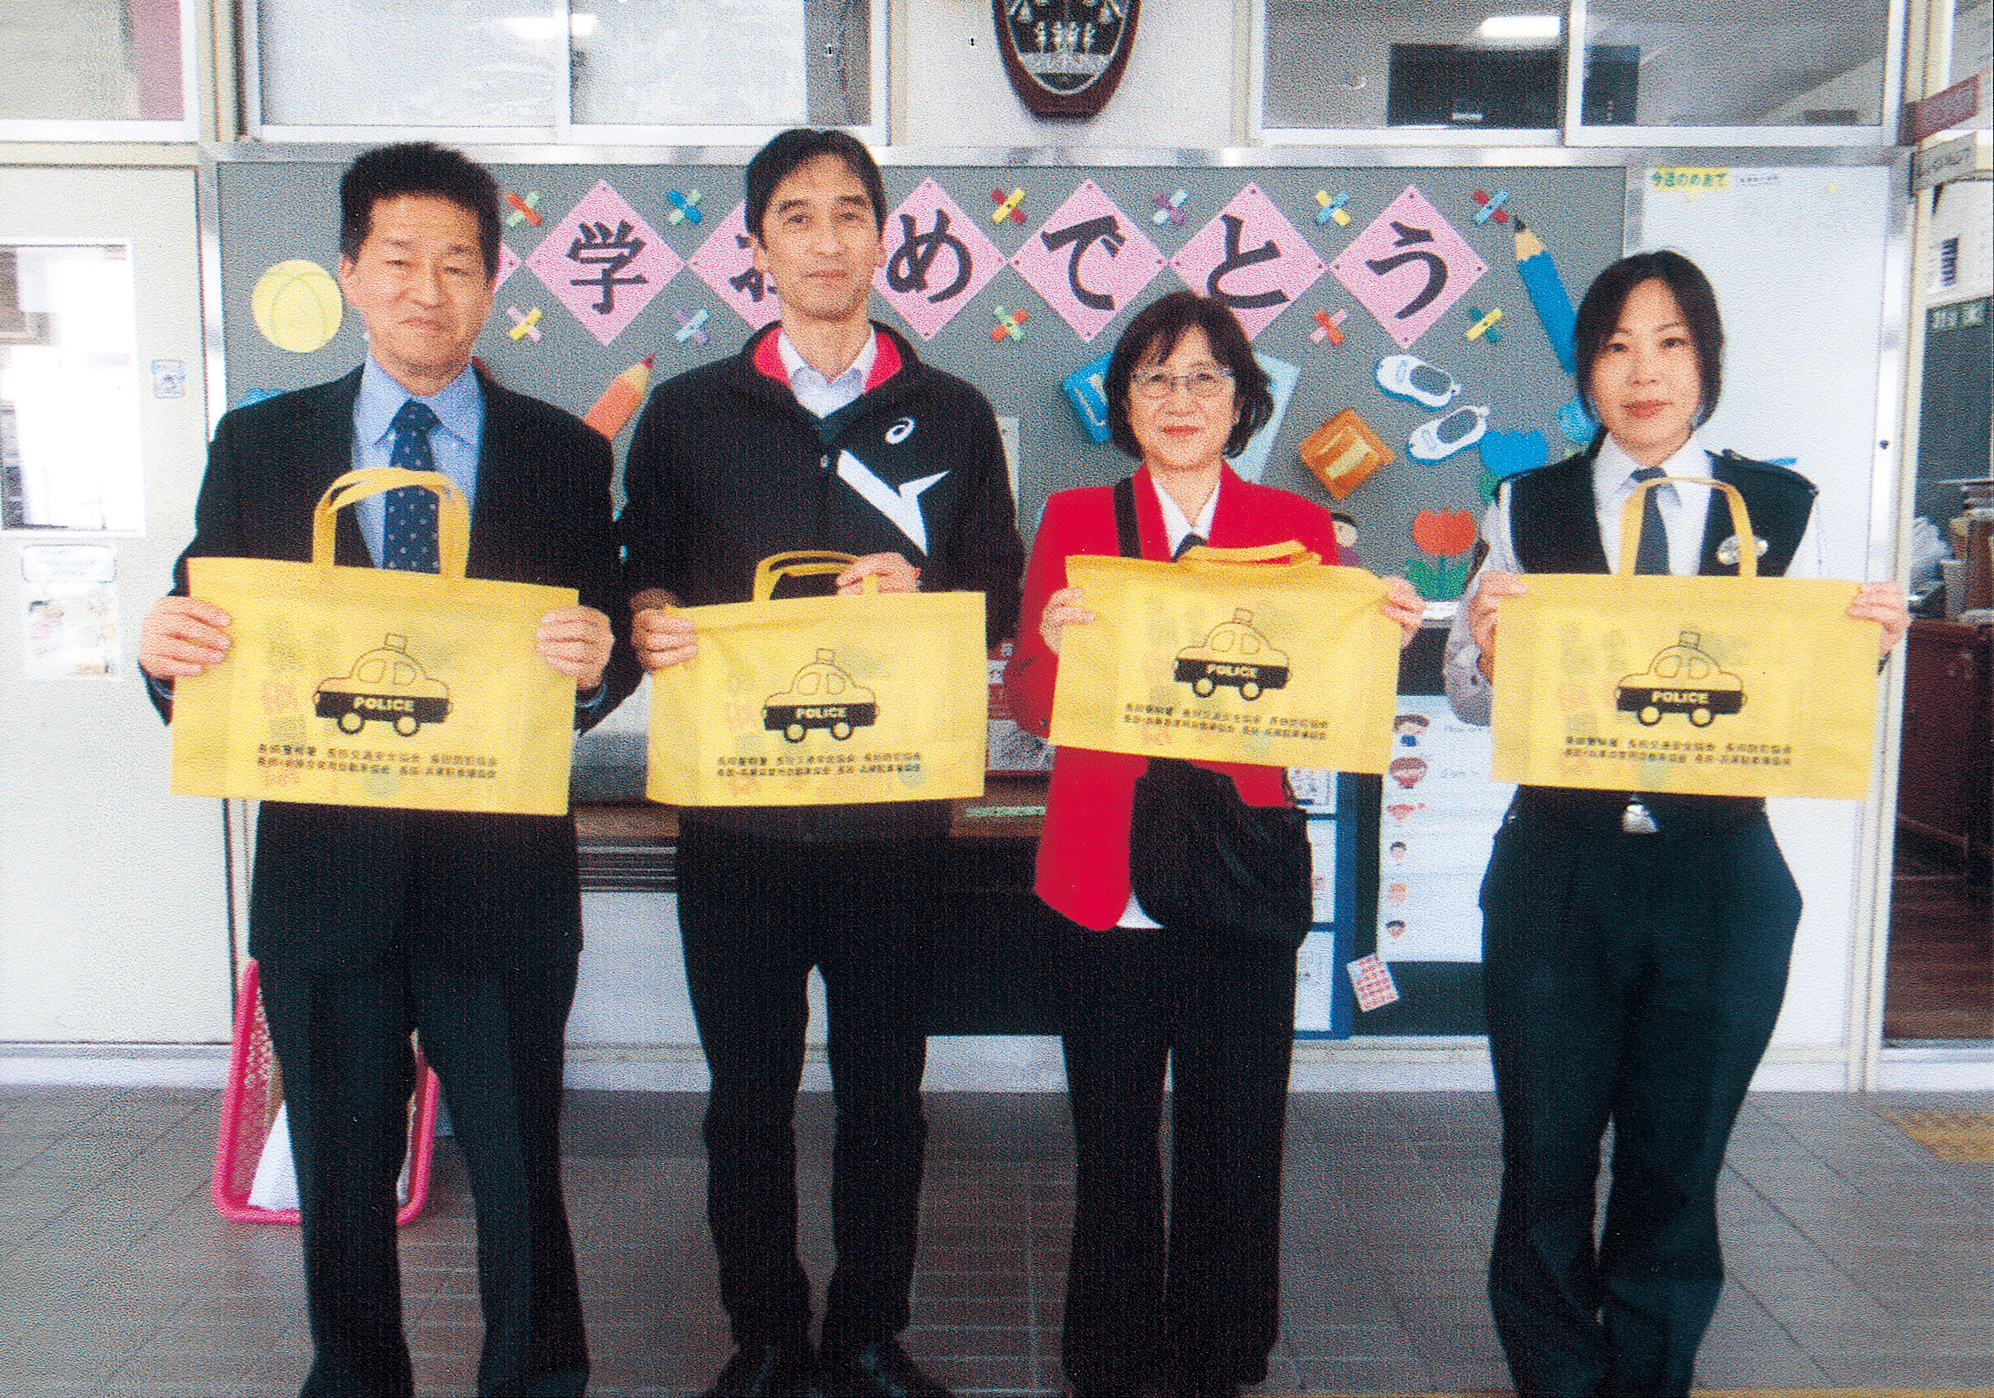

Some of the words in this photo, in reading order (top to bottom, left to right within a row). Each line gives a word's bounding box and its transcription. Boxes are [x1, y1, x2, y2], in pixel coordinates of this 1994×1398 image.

[1205, 662, 1259, 680] POLICE
[353, 695, 415, 713] POLICE
[1651, 690, 1709, 704] POLICE
[795, 706, 849, 720] POLICE
